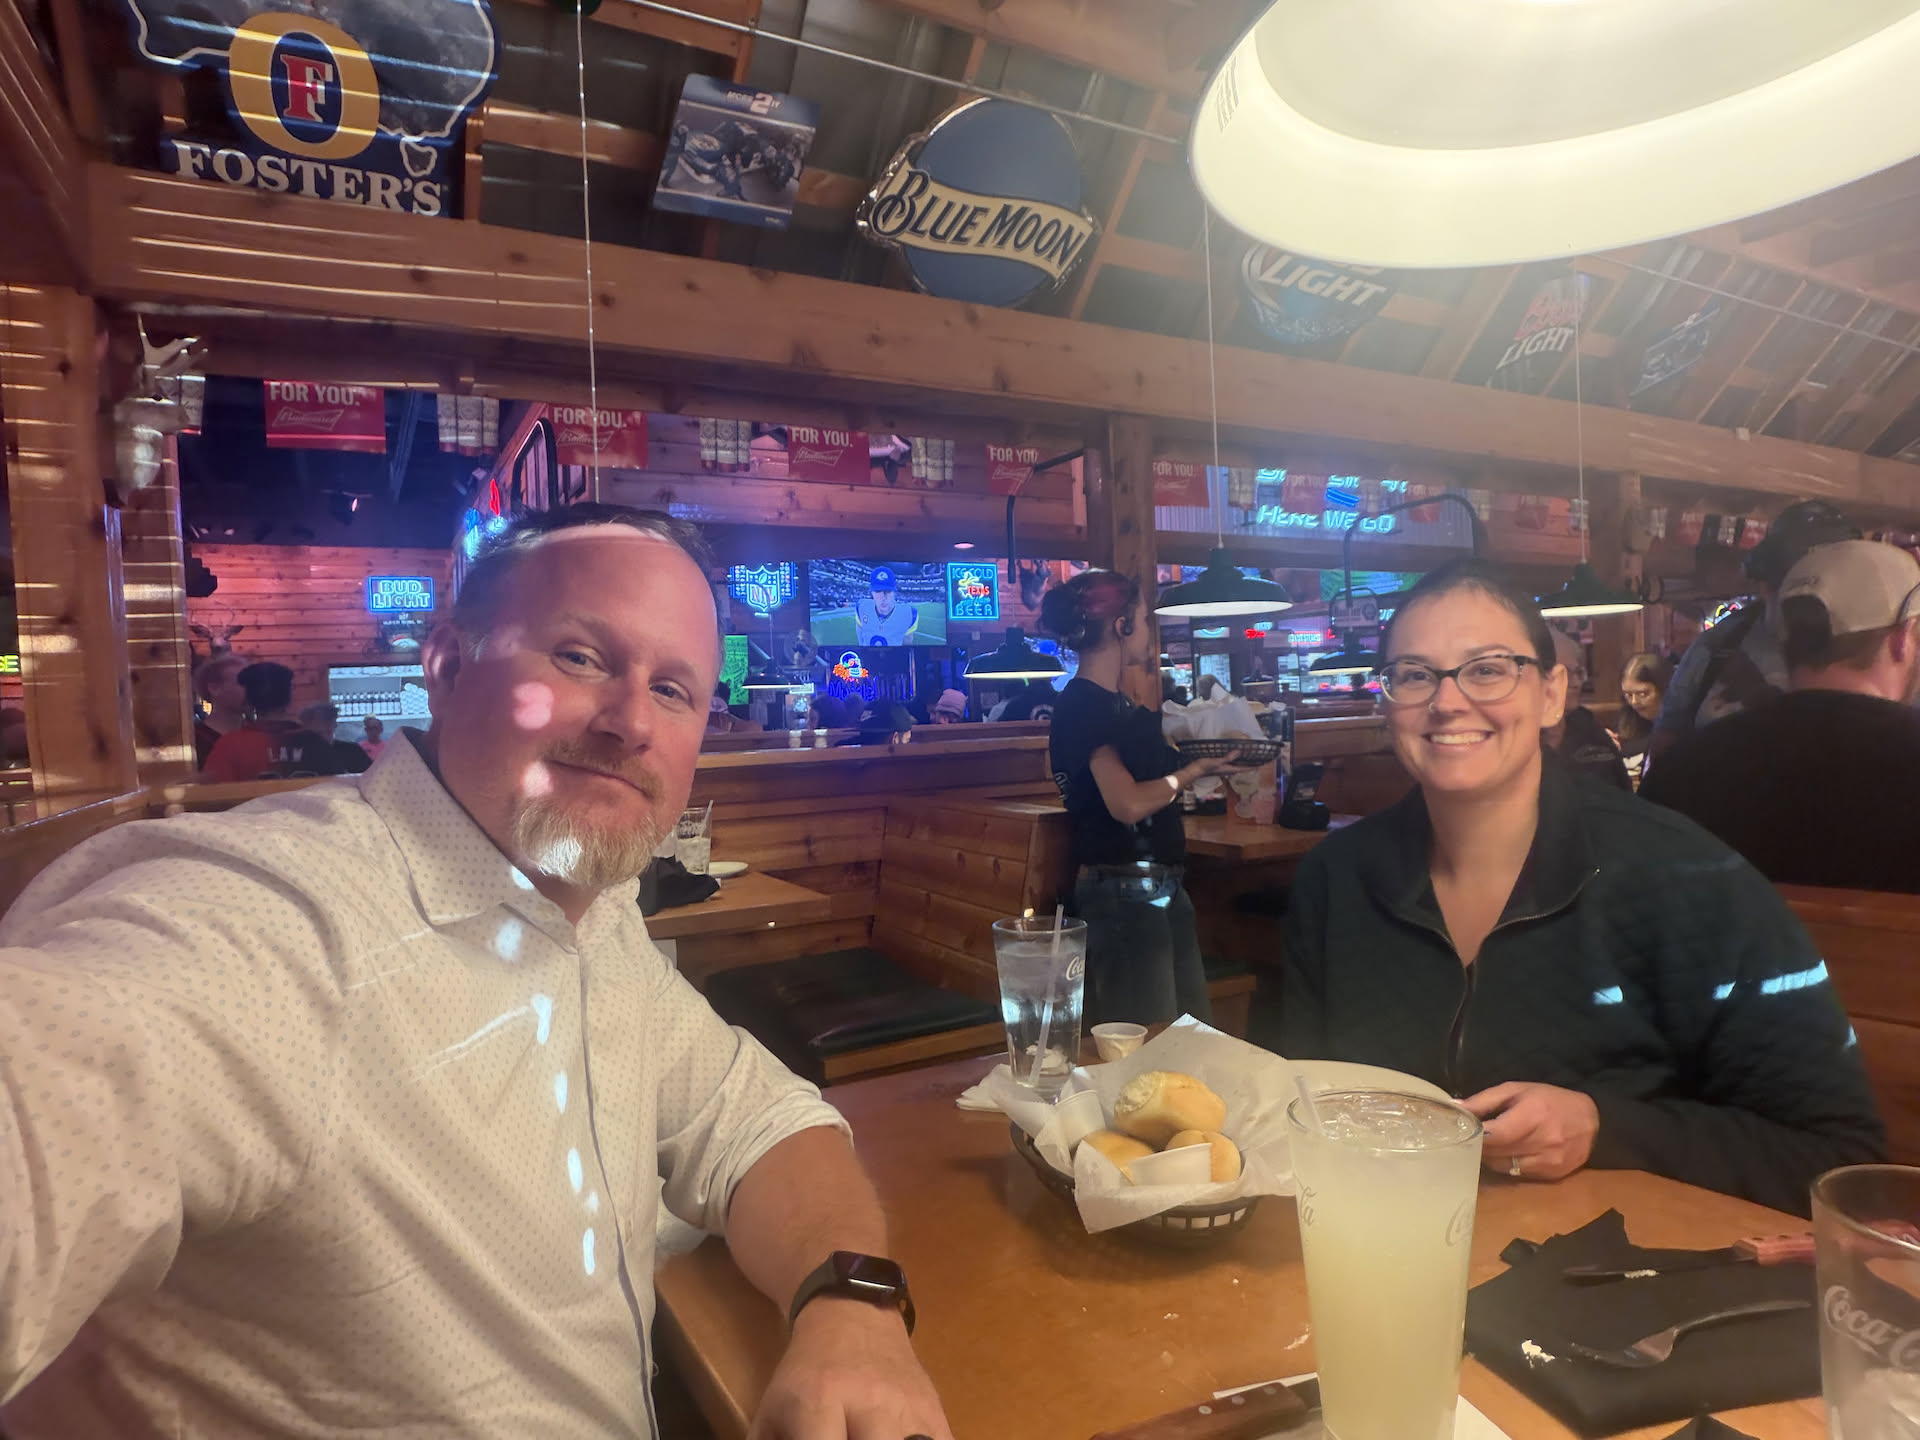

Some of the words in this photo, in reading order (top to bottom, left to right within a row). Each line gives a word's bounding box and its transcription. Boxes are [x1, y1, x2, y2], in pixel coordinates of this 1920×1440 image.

[171, 138, 441, 216] FOSTER'S
[870, 168, 990, 245] BLUE
[974, 203, 1085, 269] MOON
[1257, 254, 1386, 307] LIGHT
[1496, 326, 1574, 370] LIGHT
[270, 382, 309, 403] FOR
[553, 407, 586, 425] FOR
[791, 427, 819, 444] FOR
[822, 429, 854, 448] YOU.
[990, 447, 1013, 462] FOR
[1323, 509, 1360, 531] WE
[1358, 514, 1396, 534] GO
[379, 579, 422, 594] BUD
[372, 592, 431, 609] LIGHT
[955, 603, 993, 617] BEER
